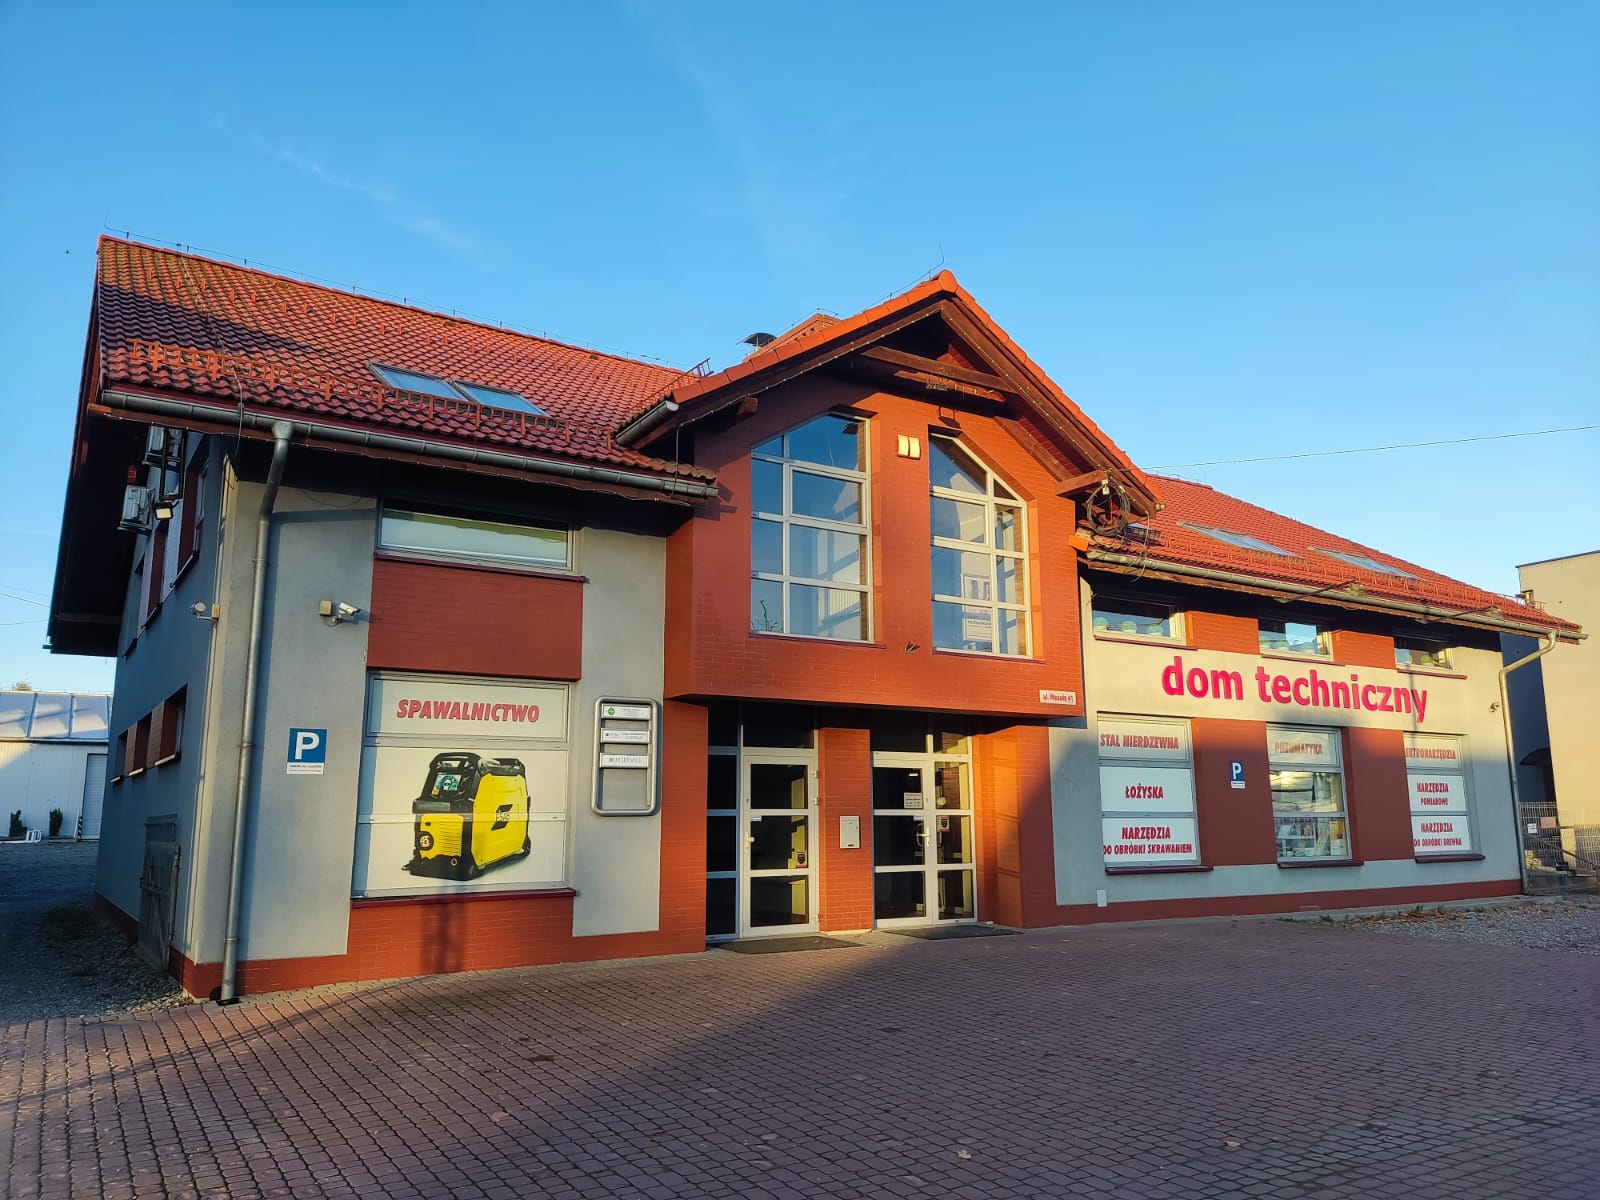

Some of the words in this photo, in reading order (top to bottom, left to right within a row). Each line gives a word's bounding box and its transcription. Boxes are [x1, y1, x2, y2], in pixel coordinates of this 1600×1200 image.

[1161, 655, 1244, 700] dom
[1255, 666, 1428, 723] techniczny
[396, 698, 540, 723] SPAWALNICTWO
[295, 731, 320, 760] P
[1100, 734, 1121, 747] STAL
[1123, 735, 1180, 749] NIERDZEWNA
[1231, 762, 1242, 780] P
[1125, 782, 1164, 799] ŁOŻYSKA
[1417, 783, 1449, 794] NARZĘDZIA
[1121, 827, 1171, 841] NARZĘDZIA
[1421, 822, 1453, 834] NARZĘDZIA
[1114, 842, 1146, 855] OBRÓBKI
[1147, 843, 1193, 854] SKRAWANIEM
